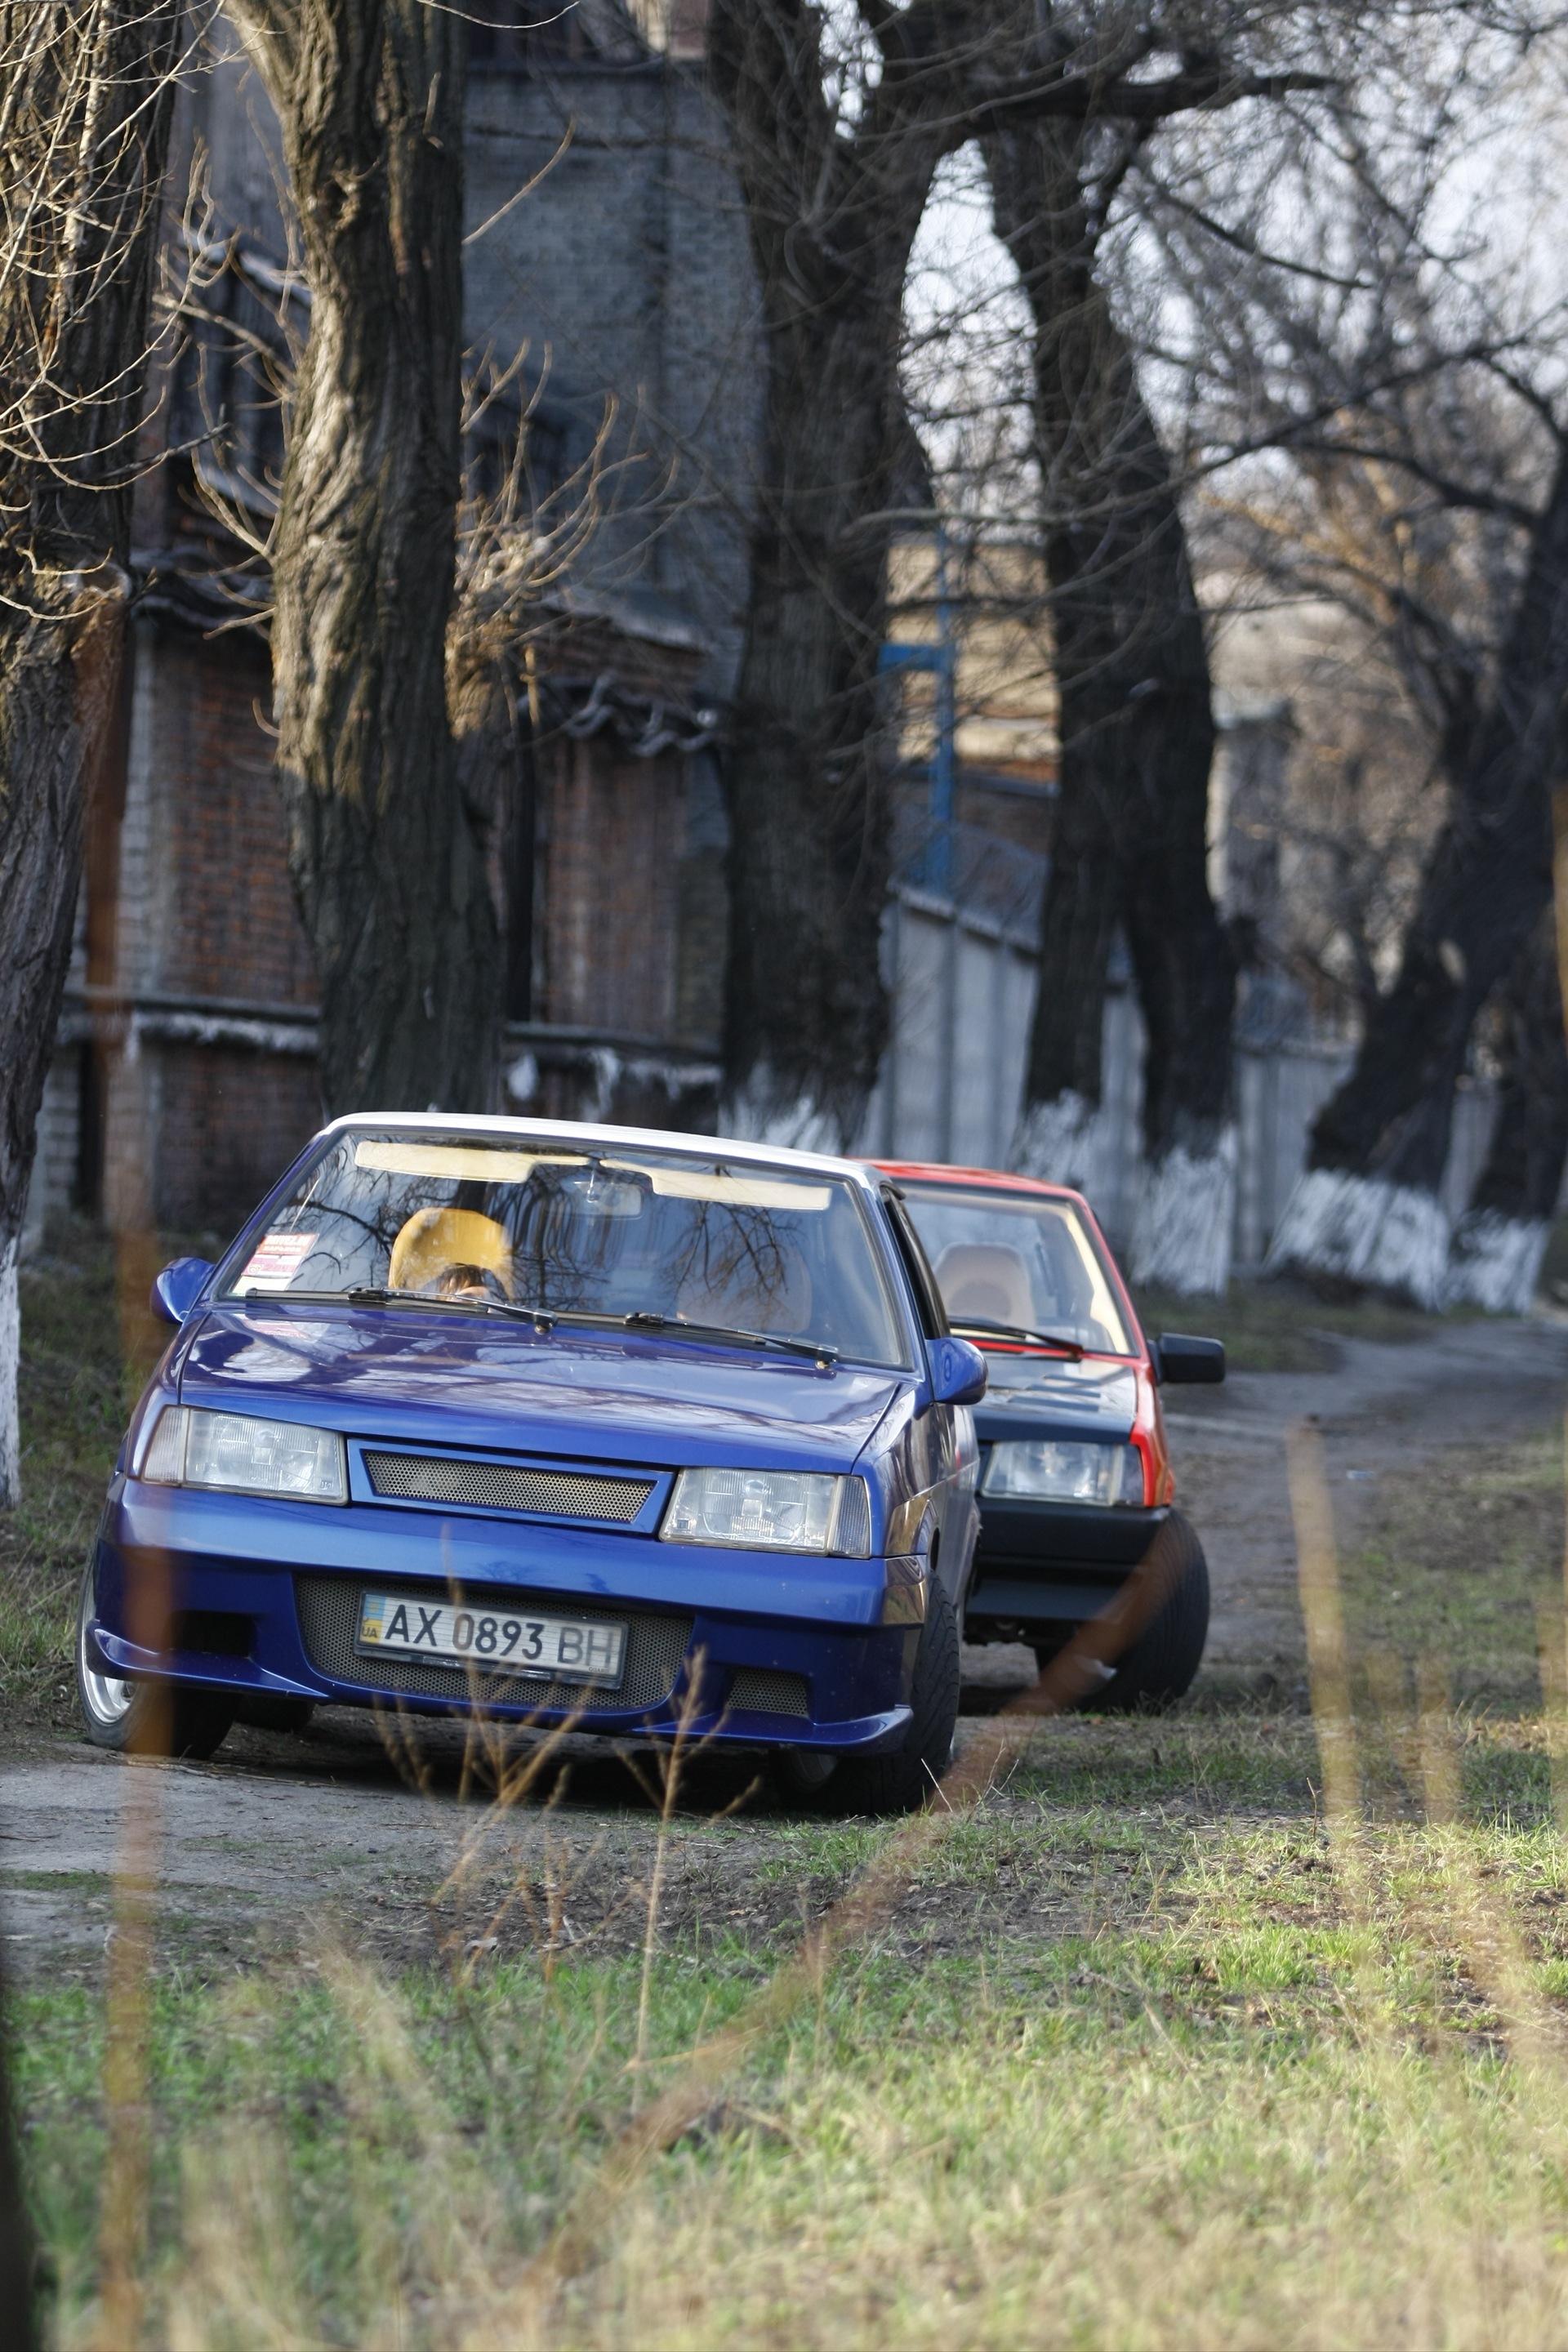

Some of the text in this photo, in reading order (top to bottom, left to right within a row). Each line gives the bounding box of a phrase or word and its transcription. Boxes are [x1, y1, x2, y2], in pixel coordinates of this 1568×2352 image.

[362, 1625, 377, 1638] UA
[385, 1604, 613, 1668] AX 0893 BH
